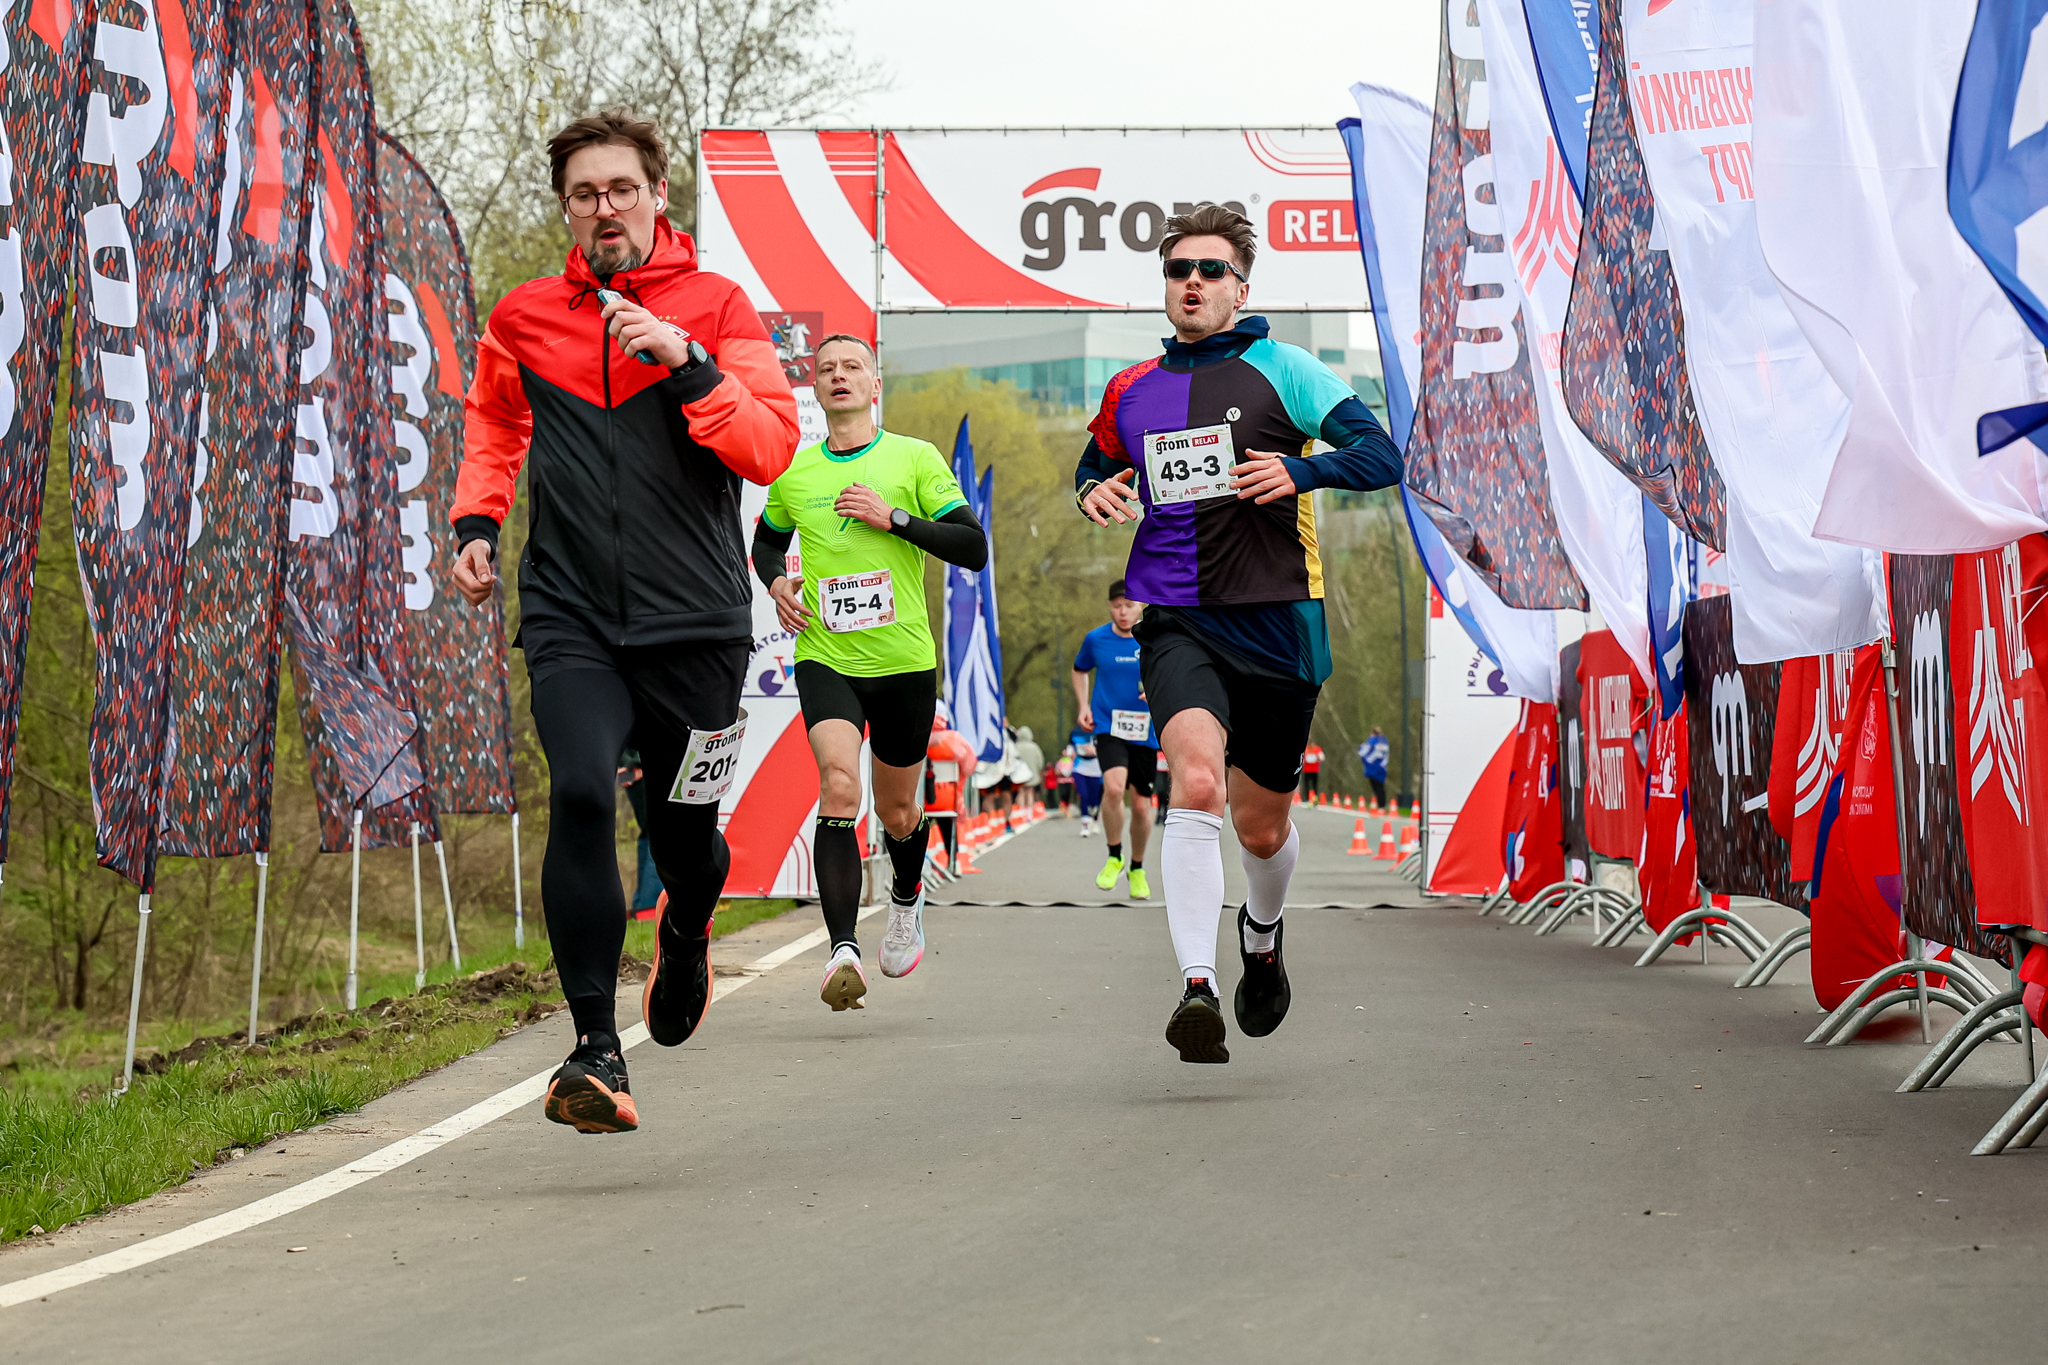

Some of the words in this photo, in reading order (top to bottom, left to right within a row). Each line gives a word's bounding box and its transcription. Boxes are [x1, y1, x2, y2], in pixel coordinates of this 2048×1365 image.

[1284, 208, 1359, 243] REL
[1156, 438, 1190, 455] grom
[1194, 436, 1216, 446] RELAY
[1161, 455, 1221, 482] 43-3
[828, 580, 859, 594] grom
[862, 577, 880, 586] RELAY
[832, 593, 882, 616] 75-4
[1116, 721, 1145, 732] 152-3
[704, 732, 737, 753] grom
